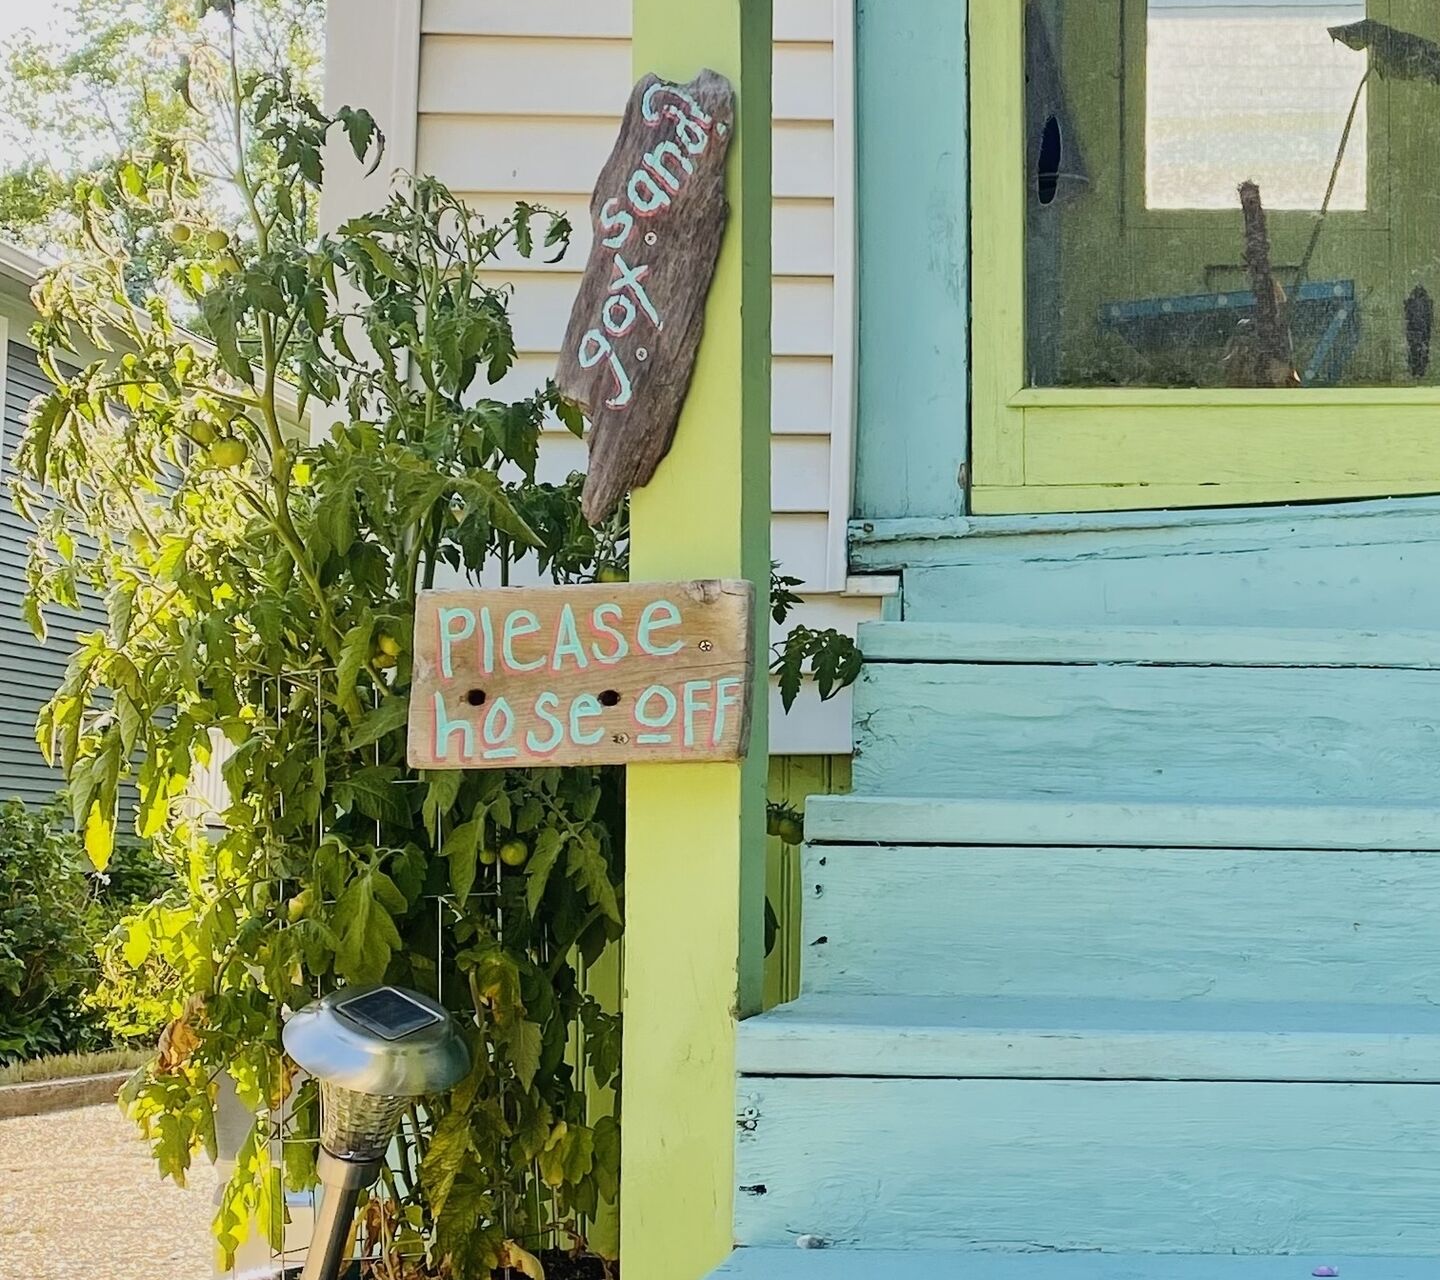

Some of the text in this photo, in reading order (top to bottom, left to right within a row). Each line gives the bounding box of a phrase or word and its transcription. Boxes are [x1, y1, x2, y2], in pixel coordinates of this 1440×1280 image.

[578, 81, 728, 410] got sand?
[431, 690, 605, 762] hose
